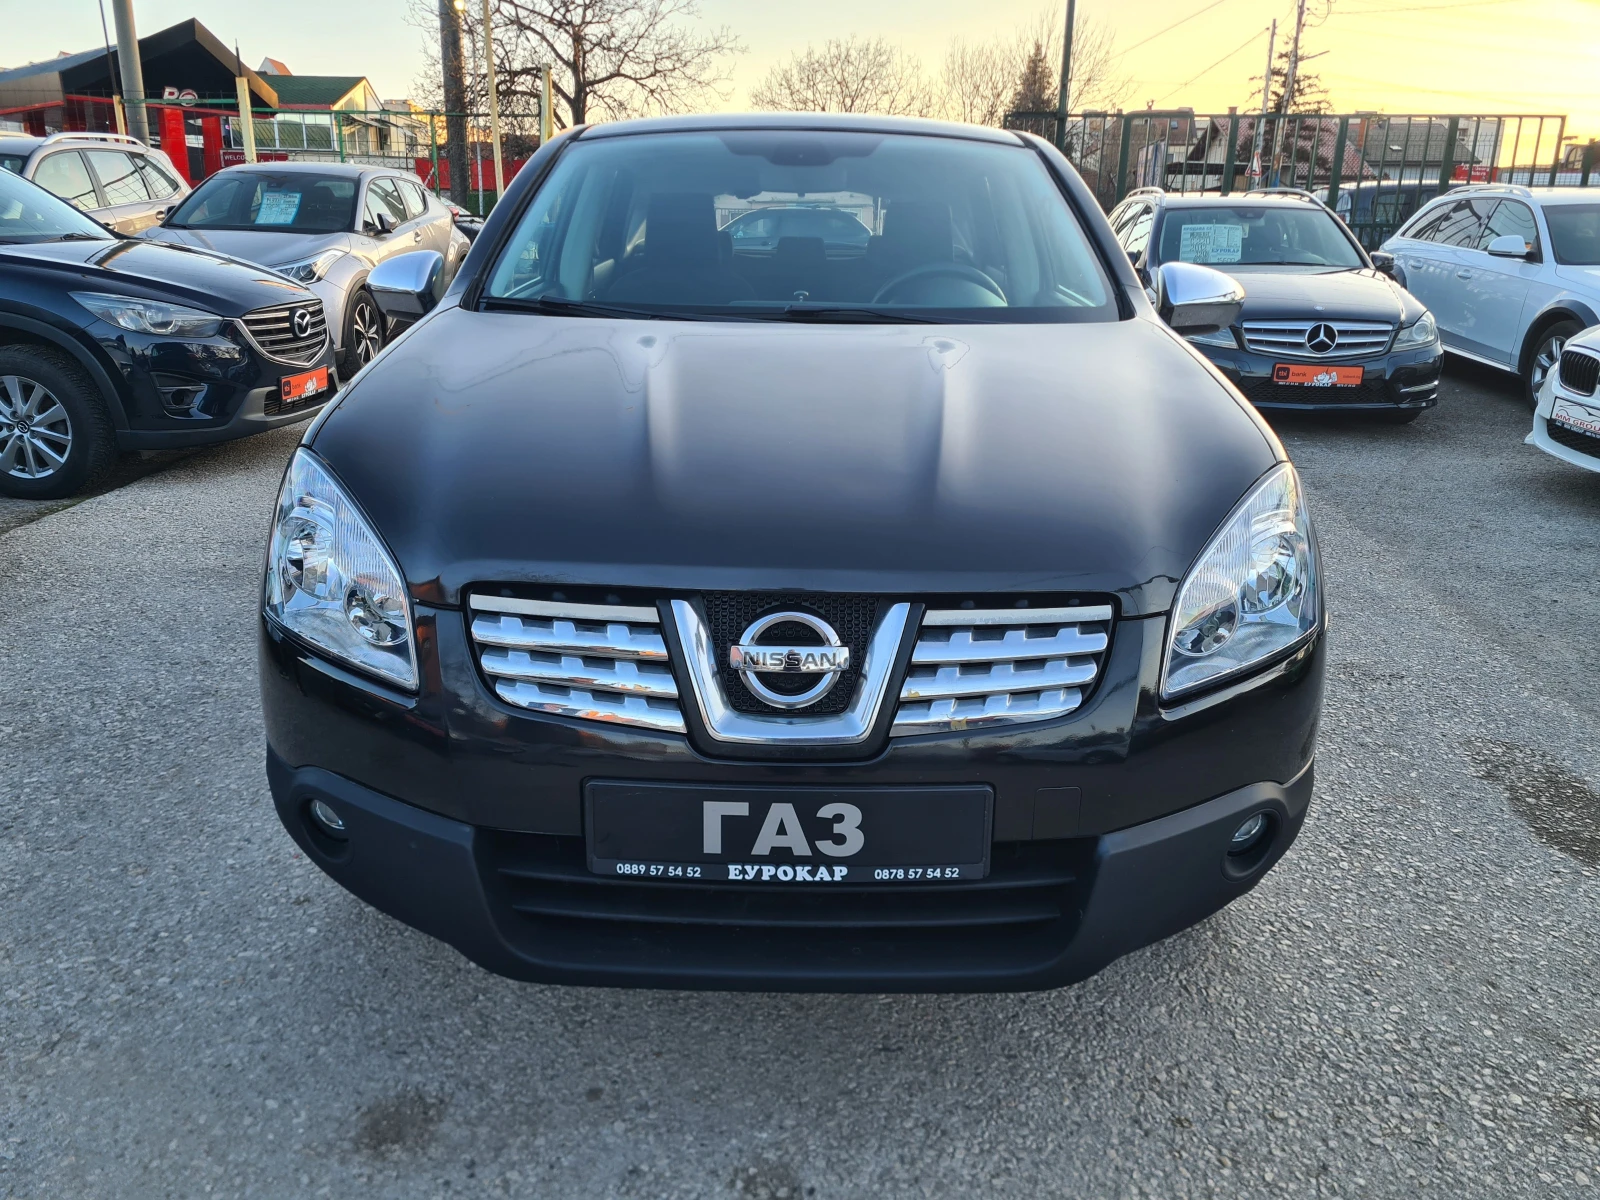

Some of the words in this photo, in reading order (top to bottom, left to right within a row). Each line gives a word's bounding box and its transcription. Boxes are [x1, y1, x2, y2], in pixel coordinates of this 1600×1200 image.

[1555, 412, 1571, 423] MM
[743, 651, 837, 668] NISSAN
[702, 800, 866, 857] ГАЗ
[616, 863, 646, 875] 0889
[649, 865, 664, 876] 57
[668, 866, 683, 877] 54
[686, 867, 701, 878] 52
[727, 864, 849, 881] ЕУРОКАР
[874, 869, 905, 880] 0878
[907, 868, 923, 879] 57
[926, 868, 941, 879] 54
[944, 867, 960, 878] 52
